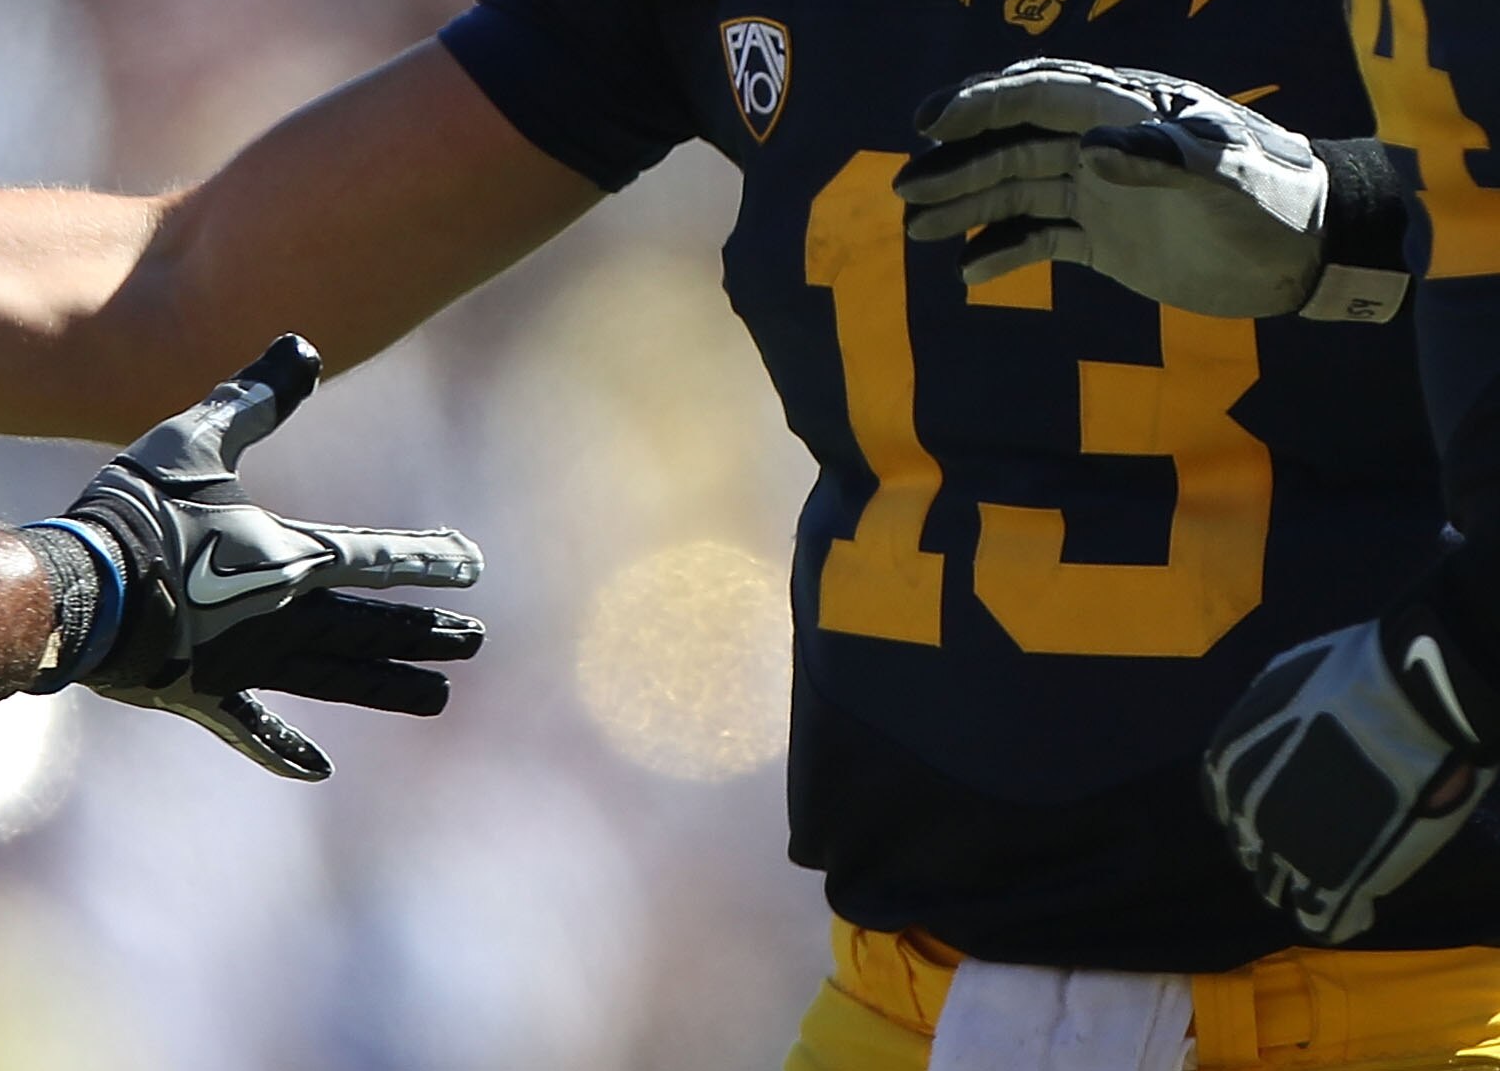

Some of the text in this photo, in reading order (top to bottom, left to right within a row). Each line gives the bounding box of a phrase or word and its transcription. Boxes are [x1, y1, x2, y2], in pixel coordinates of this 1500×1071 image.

[726, 22, 786, 94] PAC
[742, 70, 779, 115] 10
[804, 149, 1274, 658] 13
